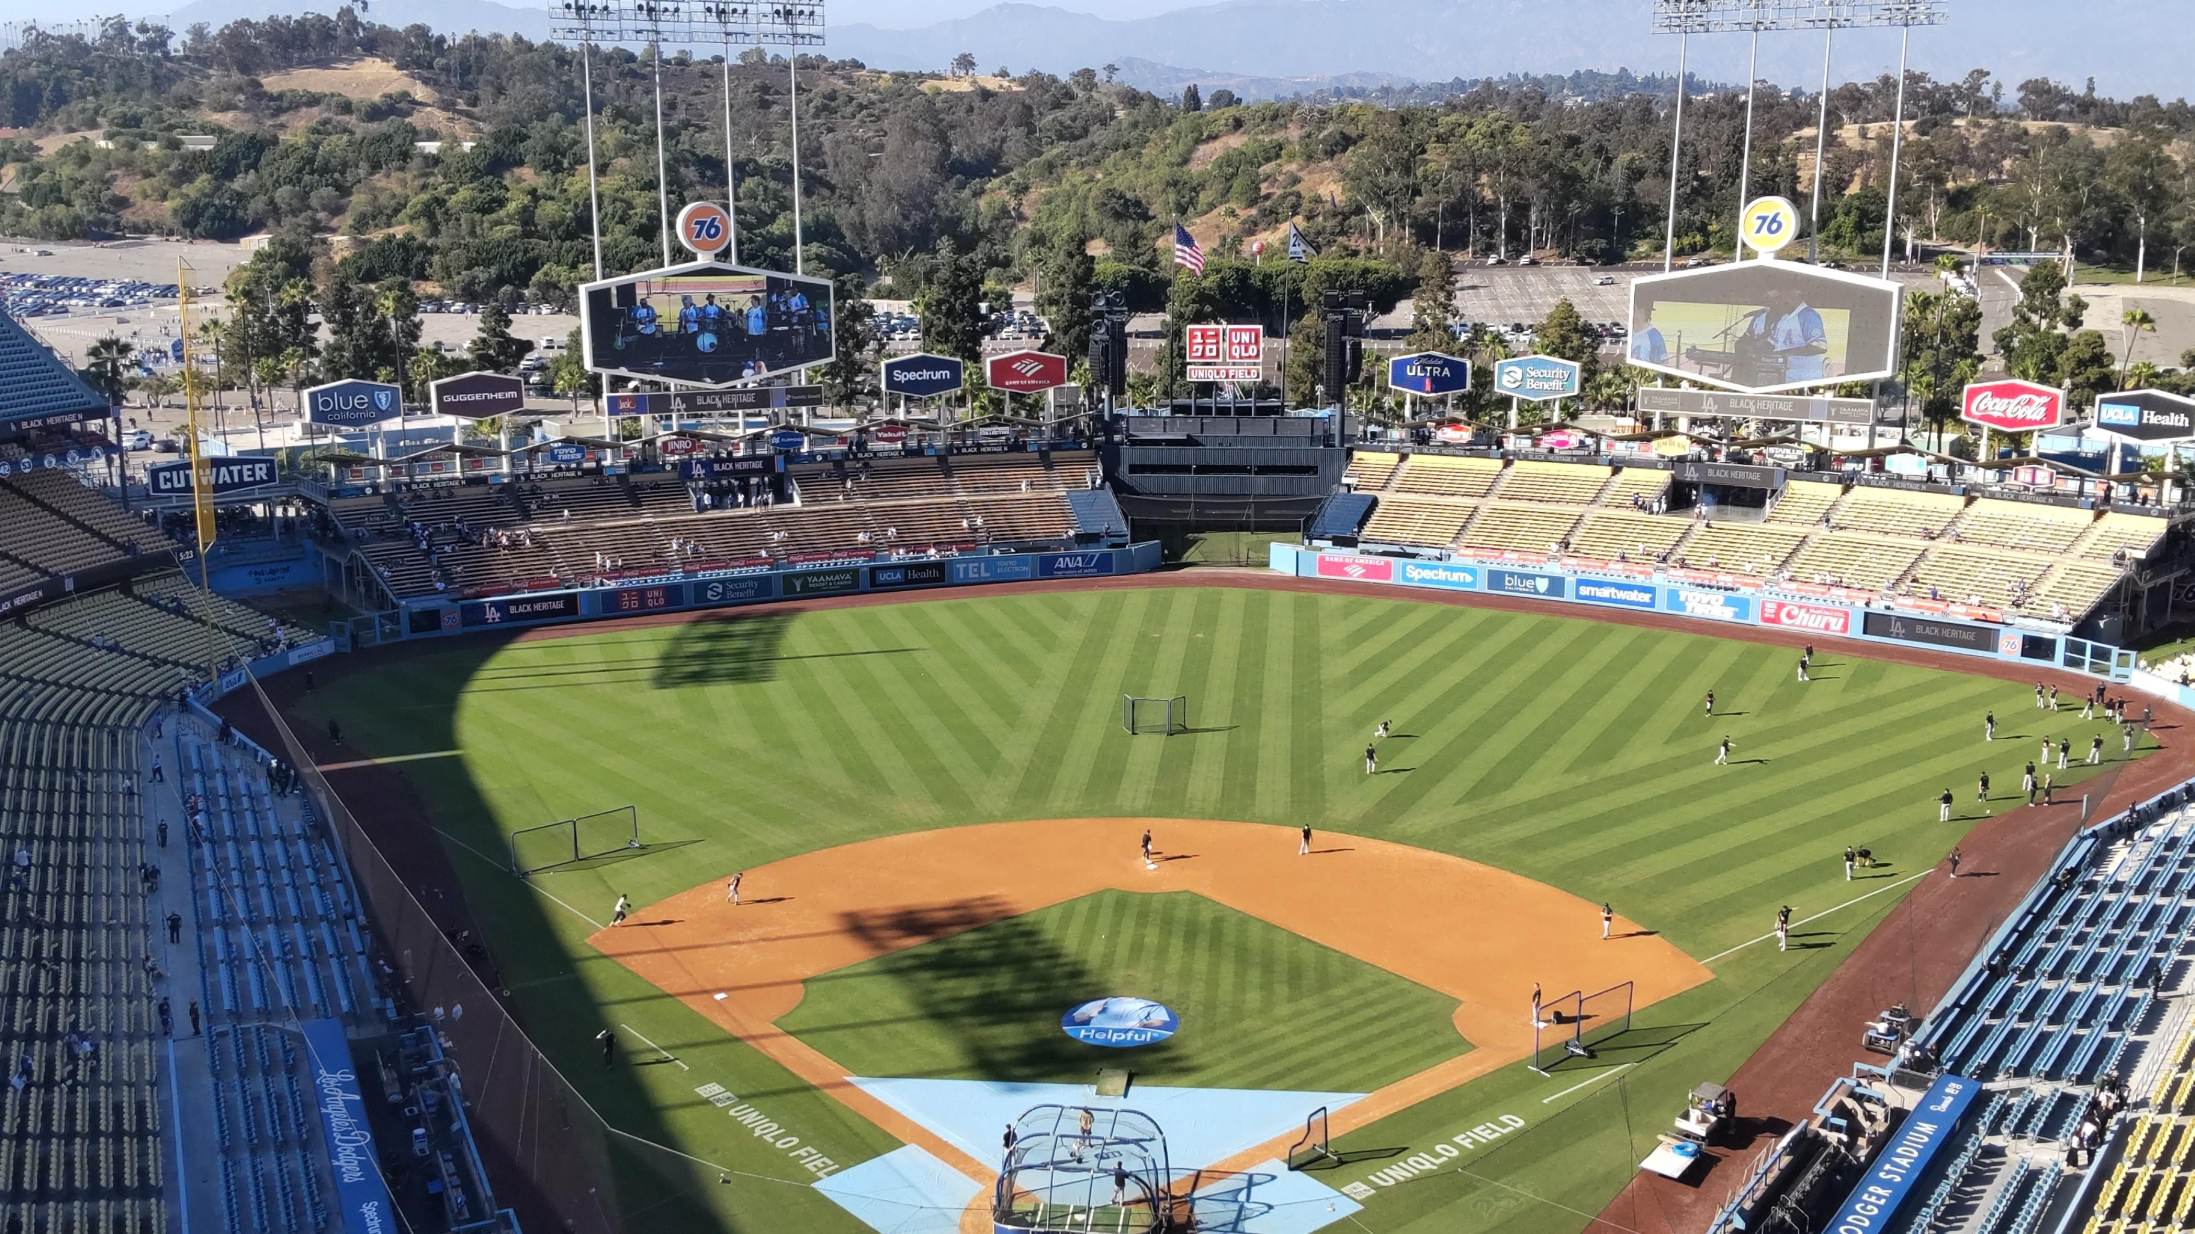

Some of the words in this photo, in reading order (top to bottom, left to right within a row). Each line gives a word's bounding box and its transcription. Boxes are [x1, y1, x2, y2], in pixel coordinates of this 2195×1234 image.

[693, 216, 723, 240] 76
[1755, 212, 1783, 235] 76
[1231, 331, 1256, 344] UNI
[1231, 345, 1258, 359] QLO
[893, 369, 951, 384] Spectrum
[1191, 369, 1227, 380] UNIQLO
[1229, 369, 1258, 379] FIELD
[1406, 366, 1450, 379] ULTRA
[1526, 367, 1570, 382] Security
[318, 392, 369, 411] blue
[443, 391, 518, 402] GUGGENHEIM
[697, 395, 721, 408] BLACK
[723, 393, 757, 408] HERITAGE
[1730, 398, 1756, 412] BLACK
[1756, 400, 1793, 415] HERITAGE
[1971, 391, 2053, 421] Coca-Cola
[21, 420, 43, 430] BLACK
[46, 415, 78, 426] HERITAGE
[328, 411, 376, 421] california
[2142, 410, 2190, 427] Health
[668, 440, 692, 454] JINRO
[159, 463, 269, 490] CUTWATER
[551, 471, 576, 479] HERITAGE
[691, 460, 706, 478] LA
[713, 463, 733, 471] BLACK
[735, 460, 763, 470] HERITAGE
[1707, 469, 1728, 478] BLACK
[1730, 471, 1760, 480] HERITAGE
[412, 482, 430, 490] BLACK
[433, 480, 459, 488] HERITAGE
[955, 562, 991, 578] TEL
[1054, 557, 1083, 568] ANA
[807, 573, 851, 583] YAAMAVA
[879, 573, 901, 581] UCLA
[907, 568, 939, 580] Health
[1406, 564, 1468, 583] Spectrum
[1505, 574, 1535, 588] blue
[725, 581, 759, 592] Security
[726, 588, 755, 599] Benefit
[1578, 585, 1652, 602] smartwater
[647, 598, 664, 607] QLO
[484, 603, 501, 623] LA
[509, 604, 532, 614] BLACK
[533, 600, 565, 612] HERITAGE
[1780, 606, 1845, 630] Churu
[1915, 624, 1939, 637] BLACK
[1941, 627, 1976, 641] HERITAGE
[2003, 640, 2017, 650] 76
[1080, 1029, 1151, 1042] Helpful
[729, 1104, 799, 1149] UNIQLO
[788, 1145, 841, 1179] FIEL
[333, 1131, 370, 1183] Dodgers
[1367, 1144, 1459, 1186] UNIQLO
[1452, 1114, 1526, 1149] FIELD
[1878, 1121, 1939, 1182] STADIUM
